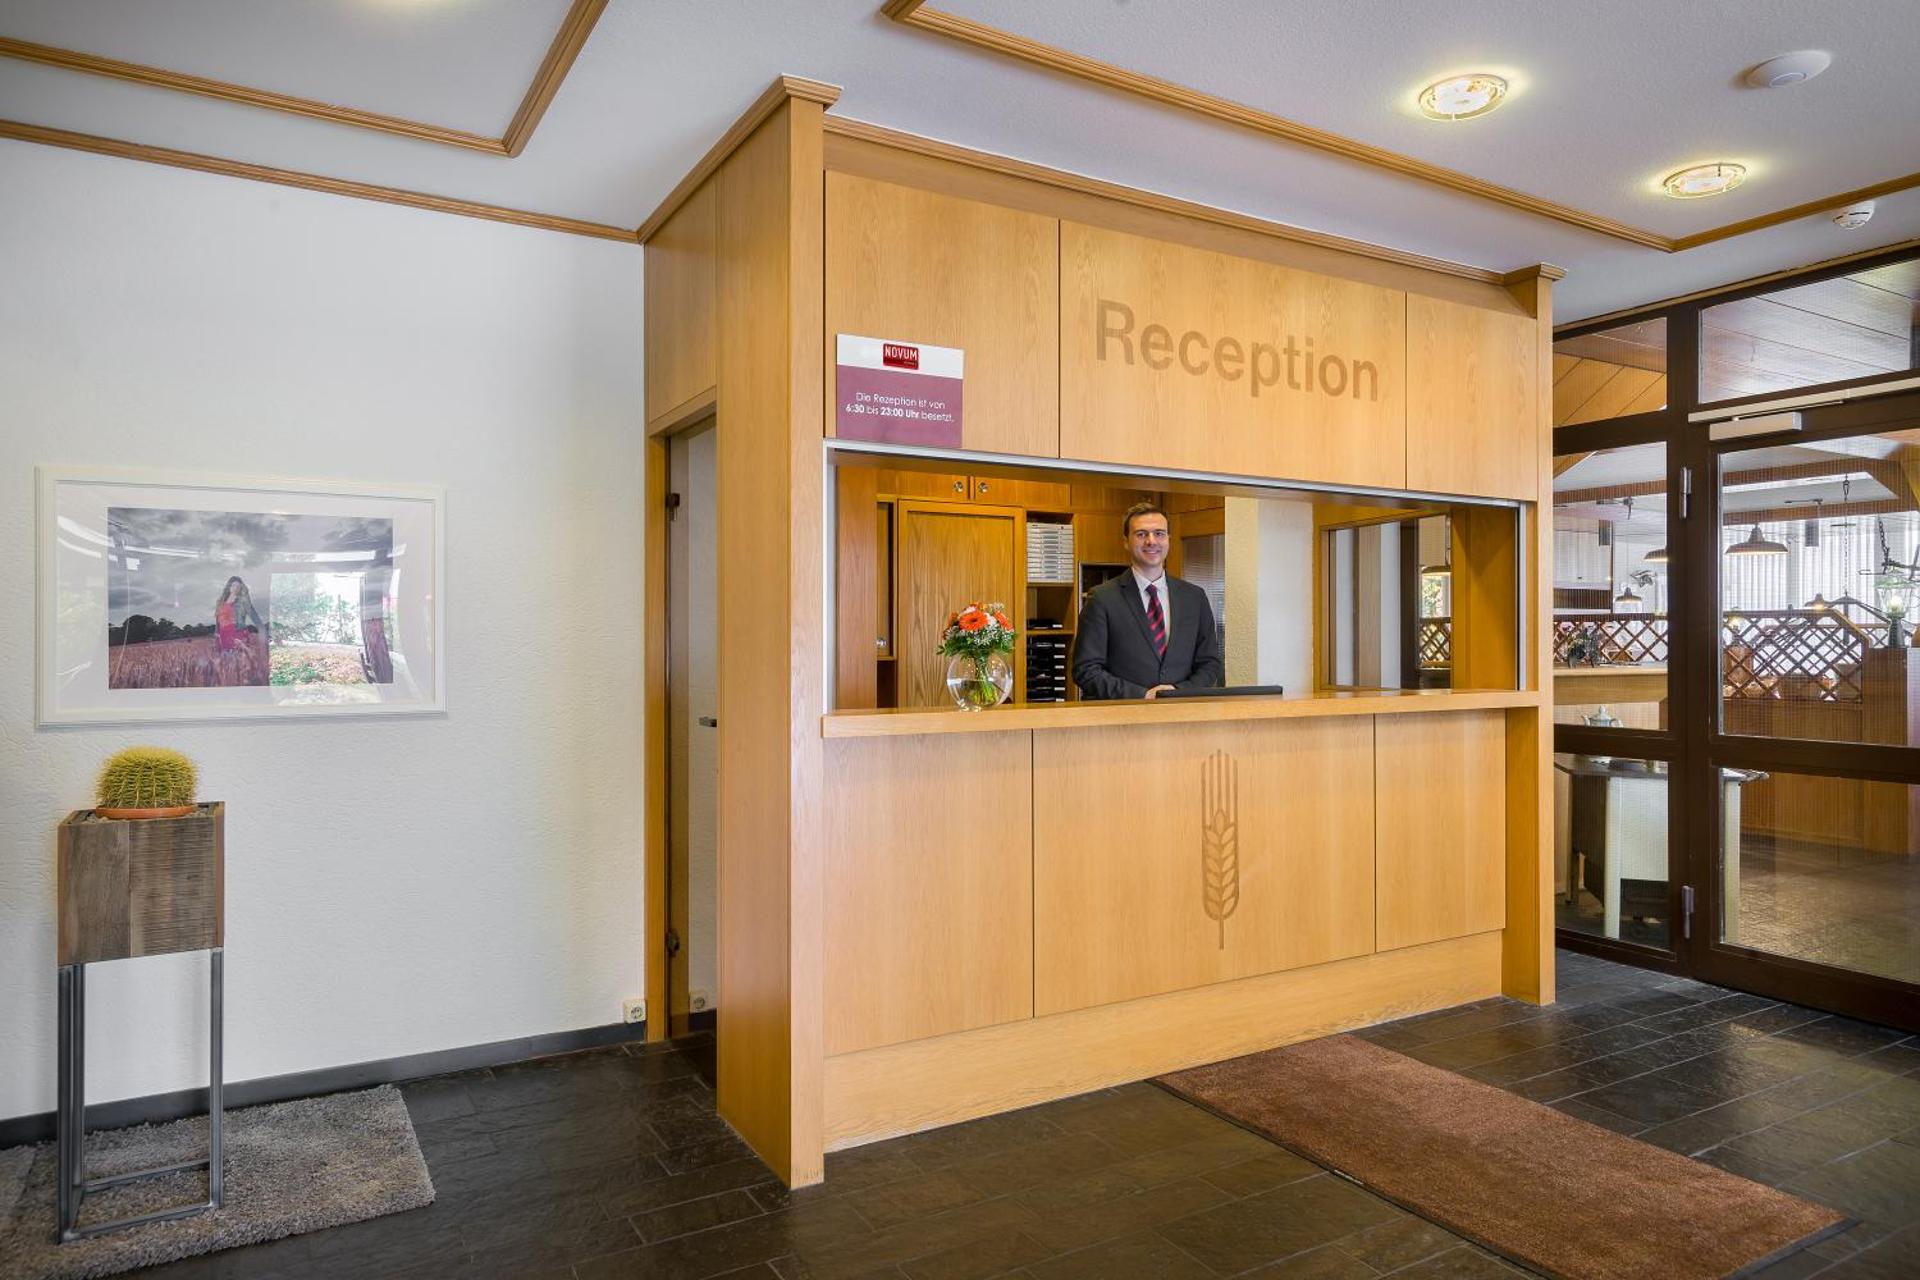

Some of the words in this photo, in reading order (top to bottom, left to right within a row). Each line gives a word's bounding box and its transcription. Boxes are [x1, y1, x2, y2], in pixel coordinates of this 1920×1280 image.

[885, 345, 917, 361] NOVUM
[1096, 299, 1378, 401] Reception
[856, 392, 871, 401] Die
[873, 393, 917, 406] Rezeption
[929, 401, 945, 409] von
[845, 403, 865, 413] 6:30
[867, 405, 879, 415] bis
[880, 406, 904, 417] 23:00
[905, 409, 920, 419] Uhr
